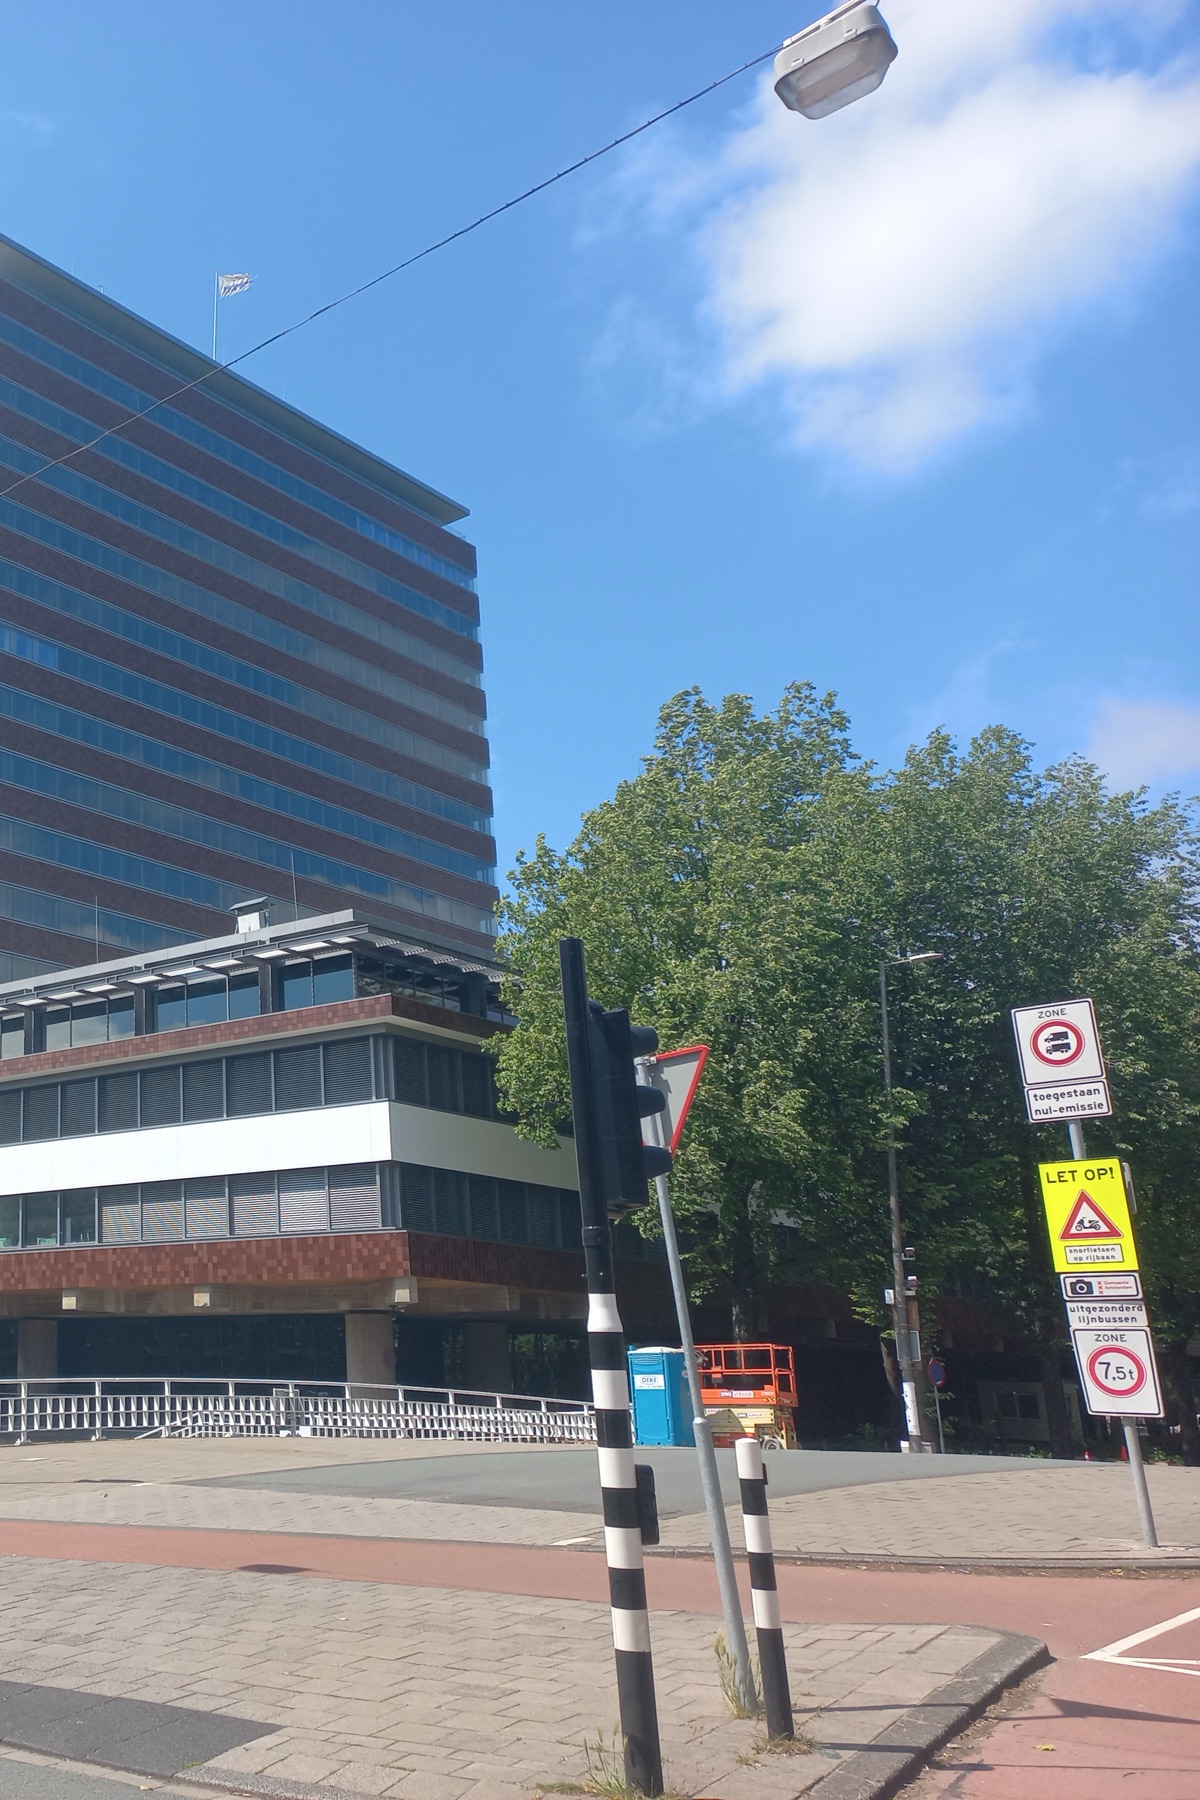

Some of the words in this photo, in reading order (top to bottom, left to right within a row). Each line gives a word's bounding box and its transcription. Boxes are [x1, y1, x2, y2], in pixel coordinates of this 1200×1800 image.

[1038, 1008, 1067, 1018] ZONE
[1033, 1088, 1100, 1102] toegestaan
[1034, 1101, 1104, 1115] nul-emissie
[1046, 1170, 1077, 1183] LET
[1084, 1167, 1115, 1181] OP!
[1086, 1254, 1116, 1262] rijbaan
[1069, 1304, 1143, 1314] uitgezonderd
[1078, 1315, 1137, 1325] lijnbussen
[1094, 1334, 1127, 1342] ZONE
